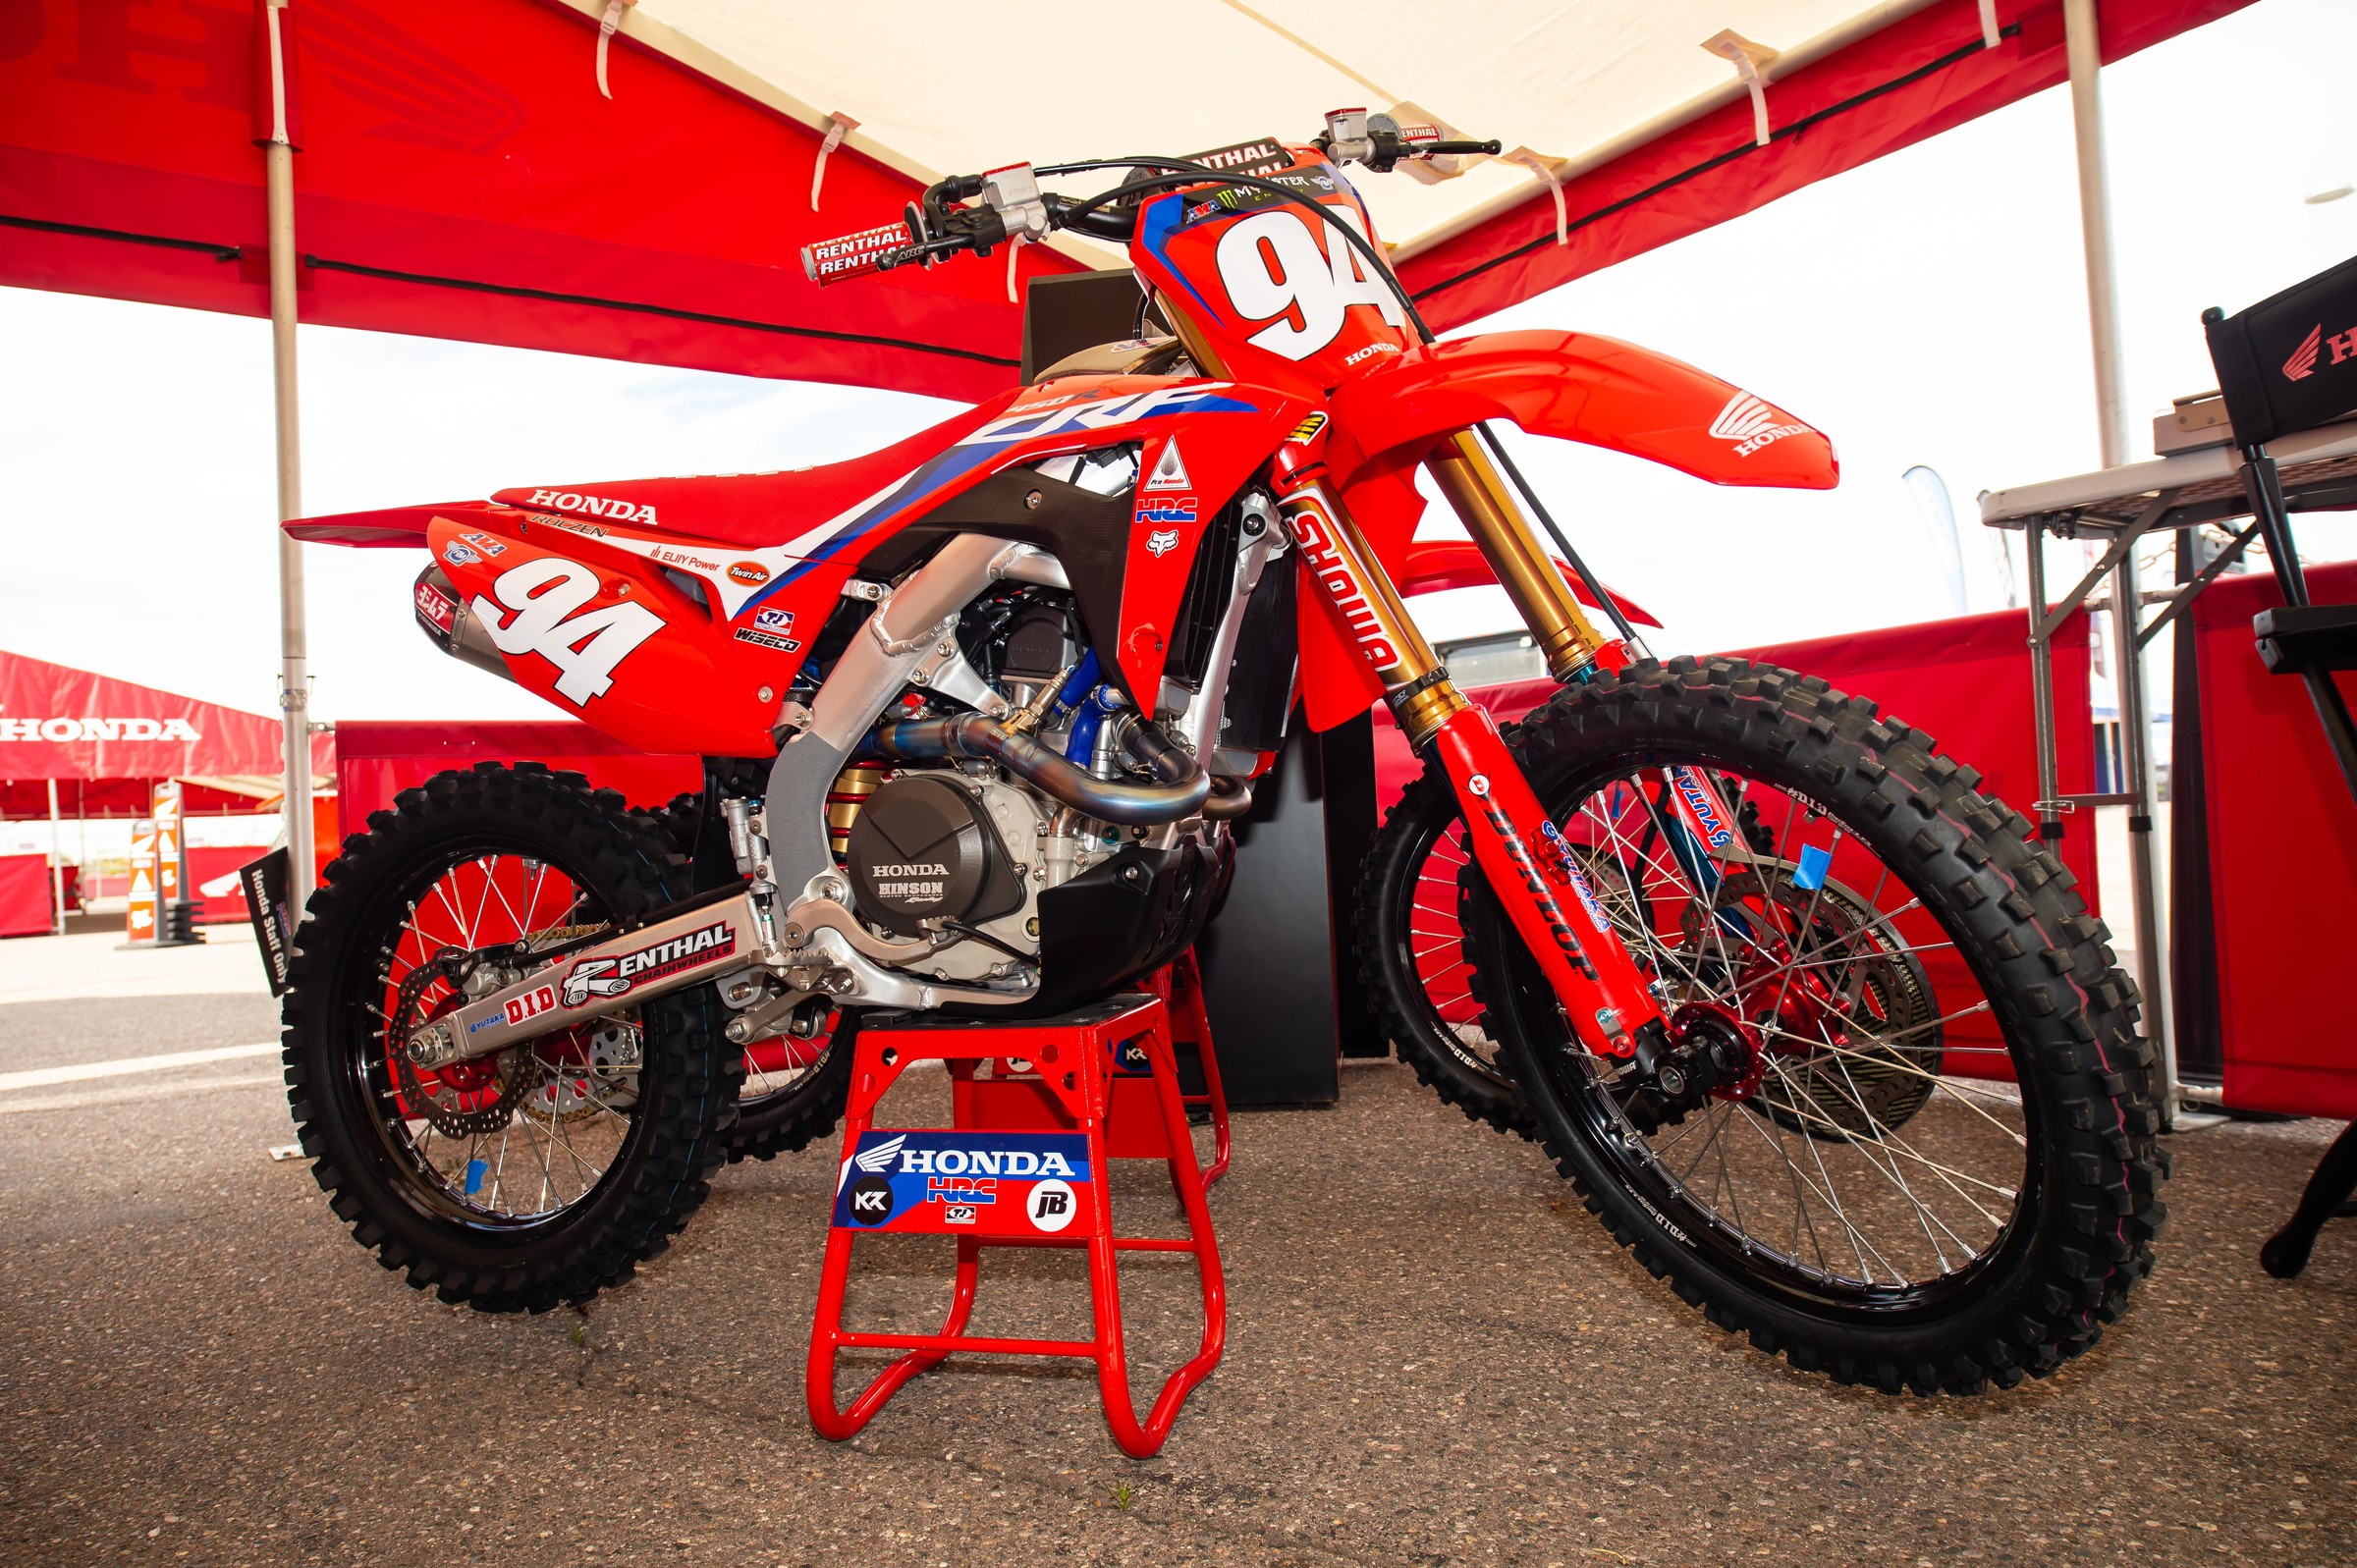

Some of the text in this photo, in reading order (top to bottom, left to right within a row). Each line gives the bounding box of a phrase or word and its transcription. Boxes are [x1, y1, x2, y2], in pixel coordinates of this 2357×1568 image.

[1400, 127, 1438, 139] ENTHAL
[1186, 199, 1221, 224] AMA
[815, 230, 907, 260] RENTHAL
[897, 245, 925, 261] ARC
[1215, 204, 1406, 361] 94
[1344, 343, 1400, 366] HONDA
[1732, 424, 1816, 458] HONDA
[525, 489, 659, 525] HONDA
[1135, 498, 1198, 523] HRC
[530, 514, 609, 538] ROCZEN
[459, 532, 507, 558] AMA
[689, 557, 720, 571] Power
[417, 585, 449, 621] ヨシムラ
[1285, 510, 1401, 672] SHOWA
[767, 612, 784, 624] TJ
[472, 557, 666, 708] 94
[0, 718, 201, 741] HONDA
[872, 864, 950, 877] HONDA
[879, 882, 944, 895] HINSON
[1485, 808, 1600, 981] DUNLOP
[251, 869, 289, 984] Honda Staff Only
[633, 945, 734, 986] CHAINWHEELS
[505, 987, 555, 1024] D.I.D
[475, 1013, 505, 1029] YUTAKA
[900, 1150, 1075, 1176] HONDA
[927, 1176, 996, 1204] HRC
[954, 1209, 967, 1217] TJ
